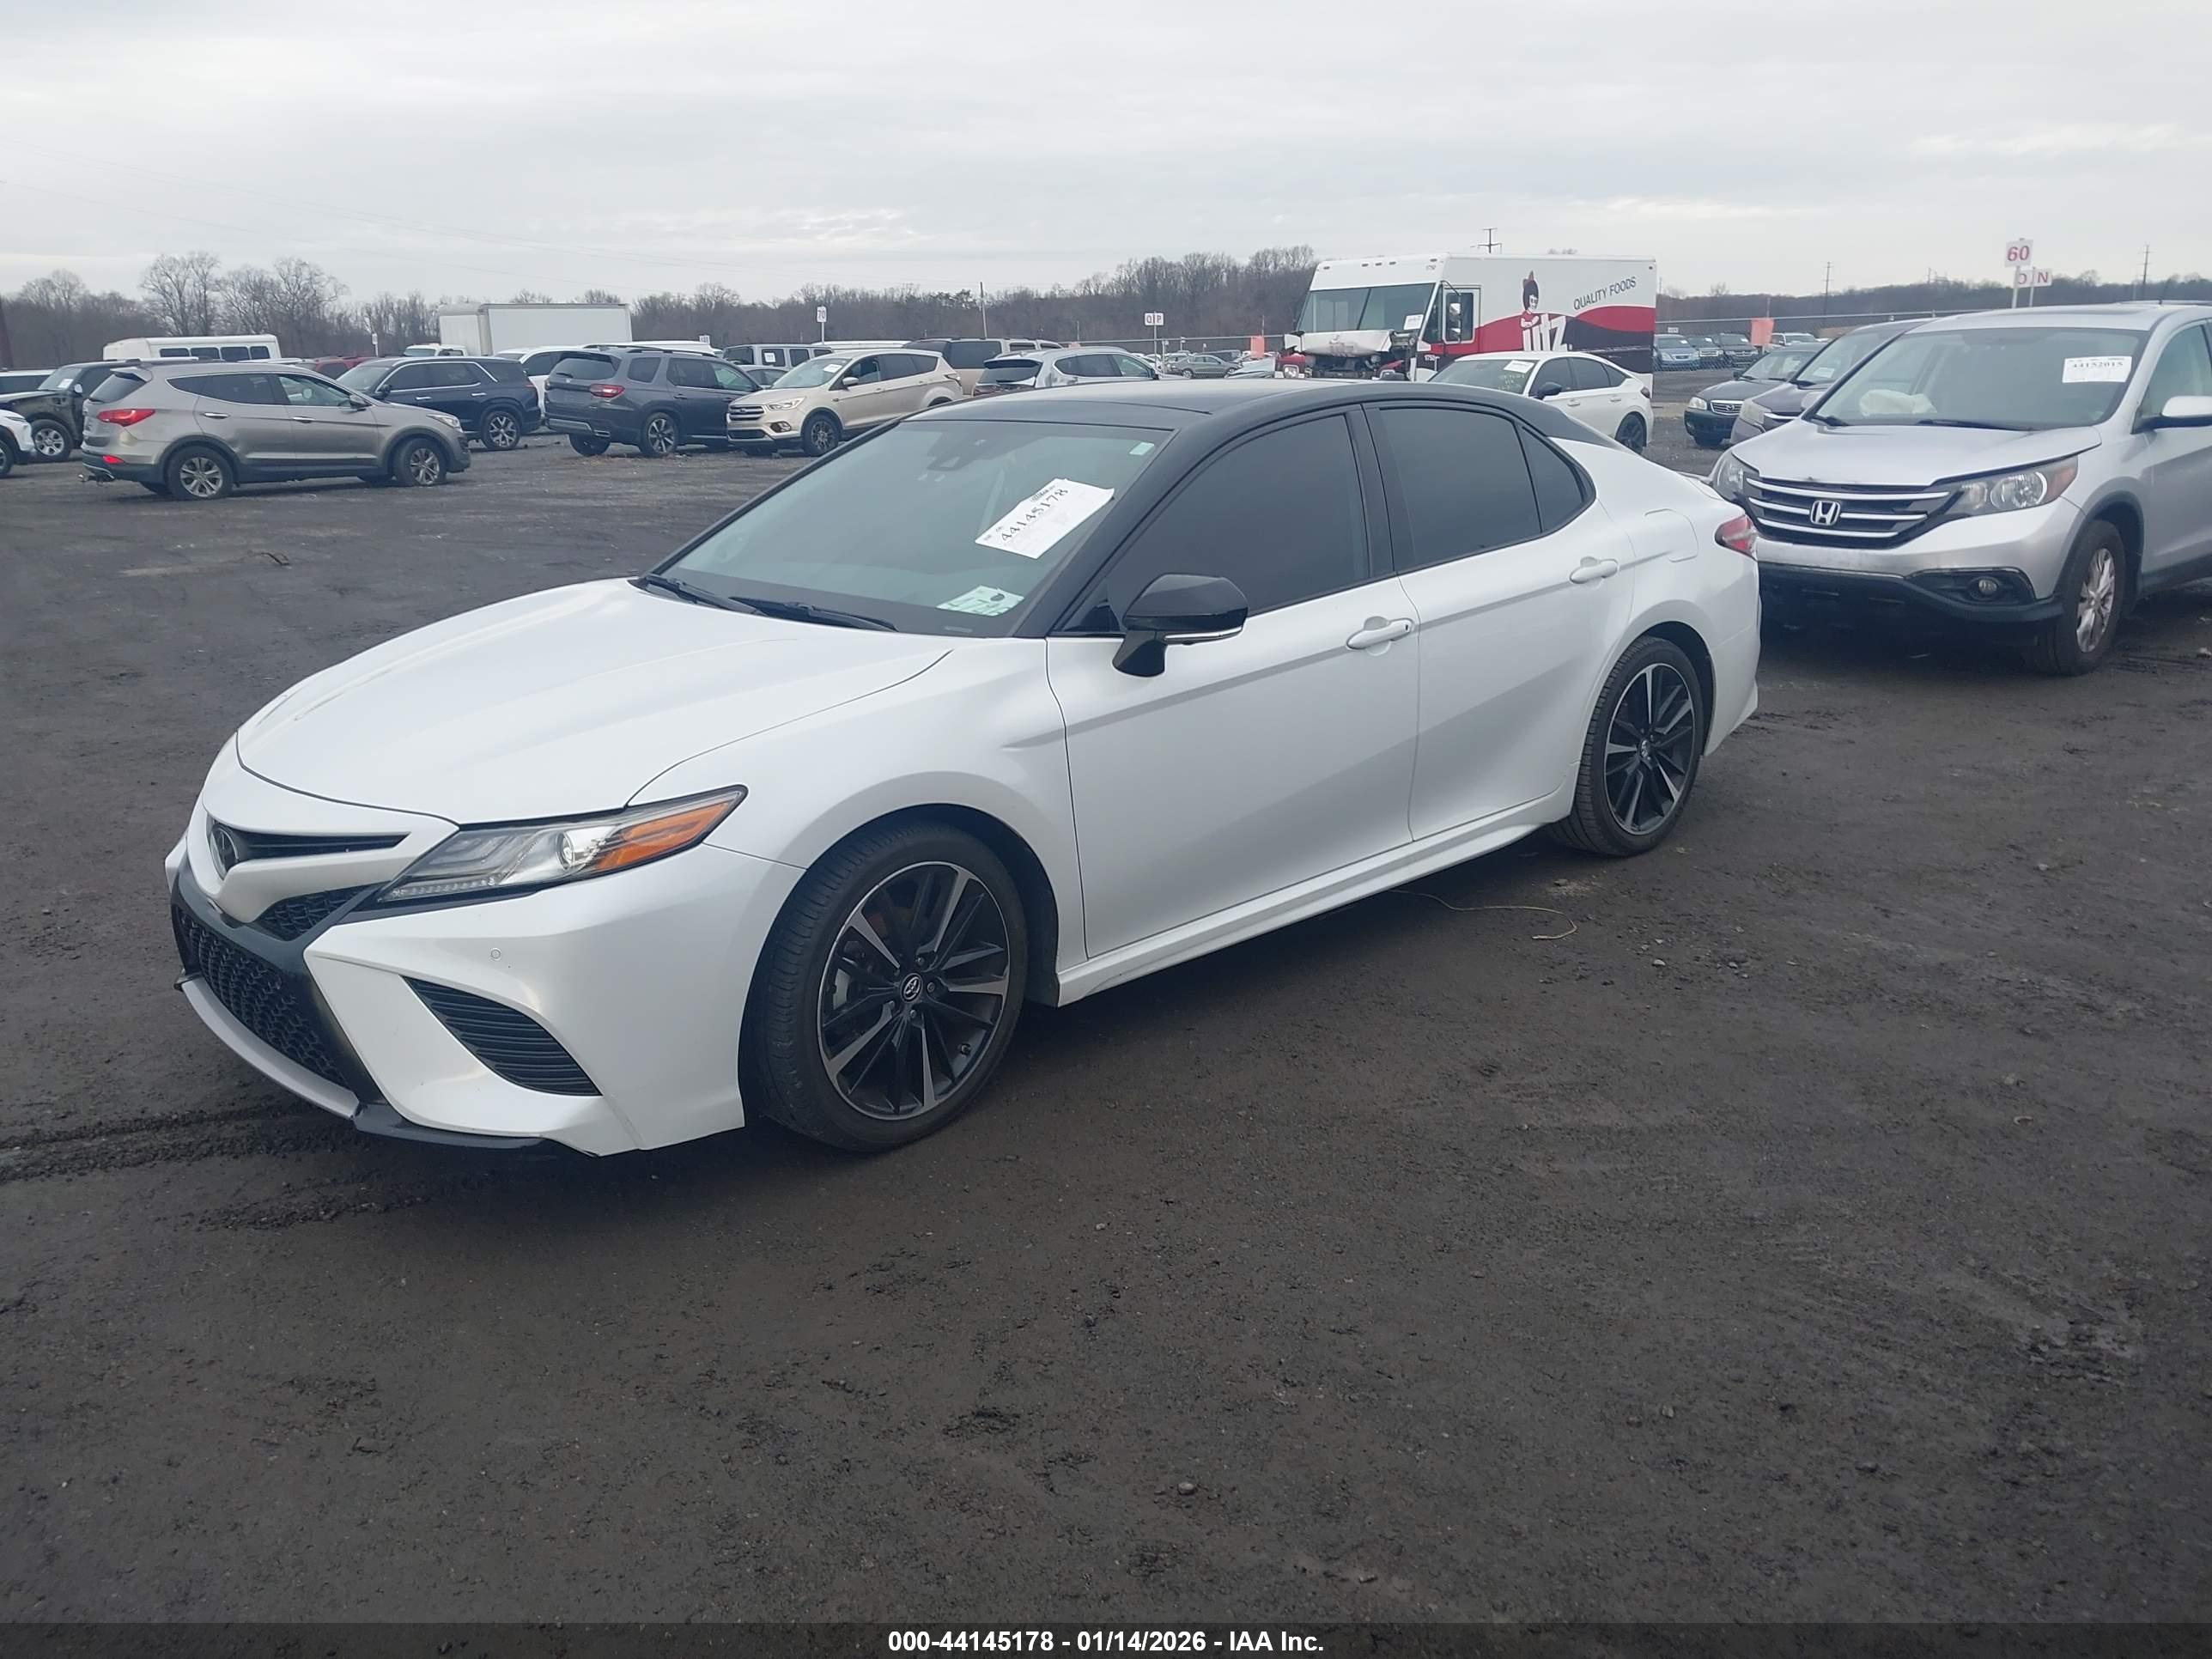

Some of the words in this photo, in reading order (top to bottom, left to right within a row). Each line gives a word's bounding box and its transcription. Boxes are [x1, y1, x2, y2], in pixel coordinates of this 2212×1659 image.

[2007, 246, 2030, 261] 60
[2037, 271, 2049, 283] N
[1573, 287, 1607, 310] QUALITY
[1608, 276, 1637, 296] FOODS
[1001, 488, 1069, 541] 44145178
